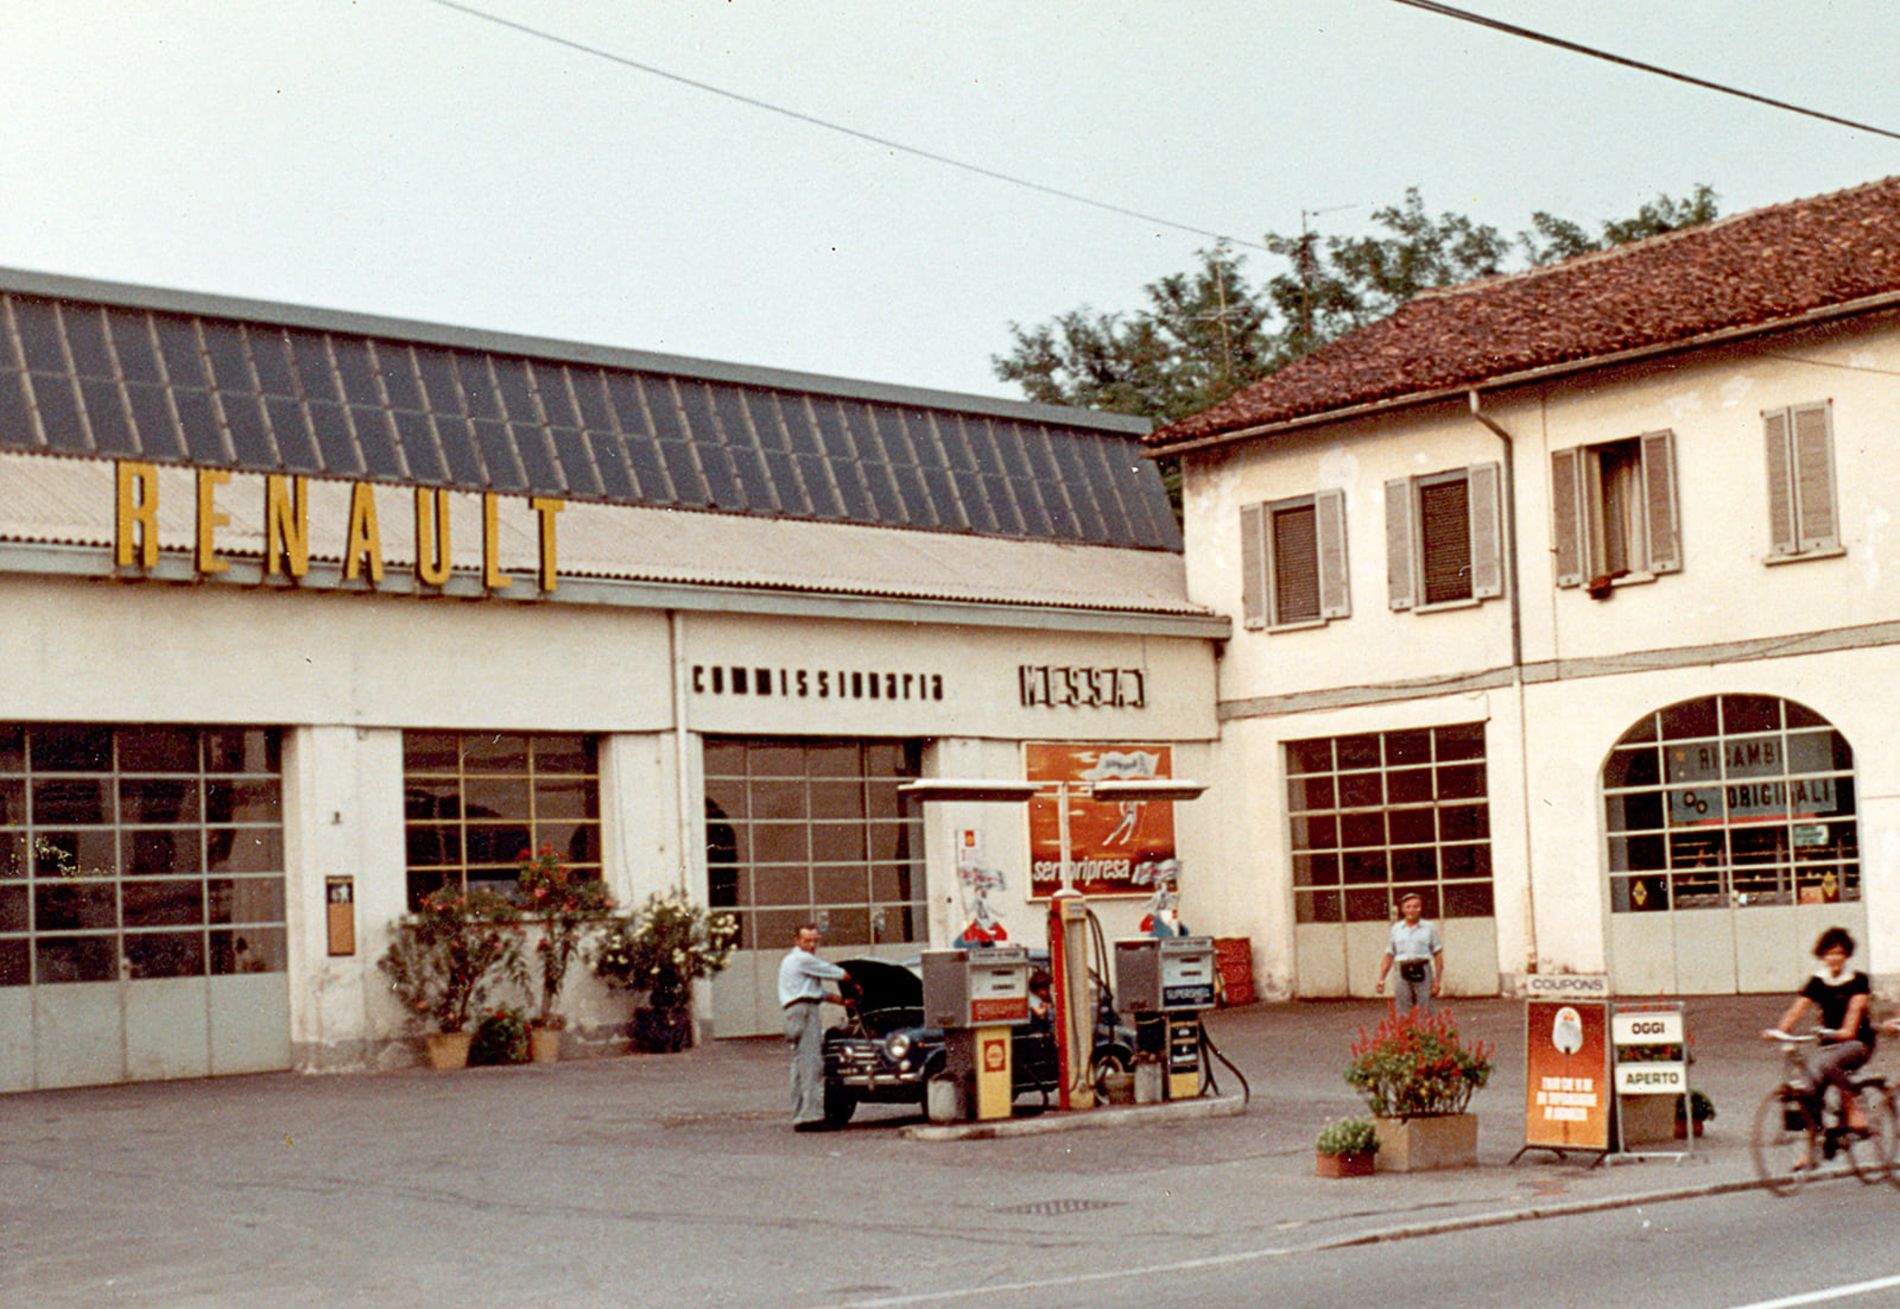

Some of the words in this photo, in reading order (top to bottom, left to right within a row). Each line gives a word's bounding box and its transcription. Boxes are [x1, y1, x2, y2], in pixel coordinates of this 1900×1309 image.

[114, 460, 565, 591] RENAULT
[1532, 978, 1603, 991] COUPONS
[1631, 1022, 1665, 1035] OGGI
[1626, 1072, 1679, 1085] APERTO
